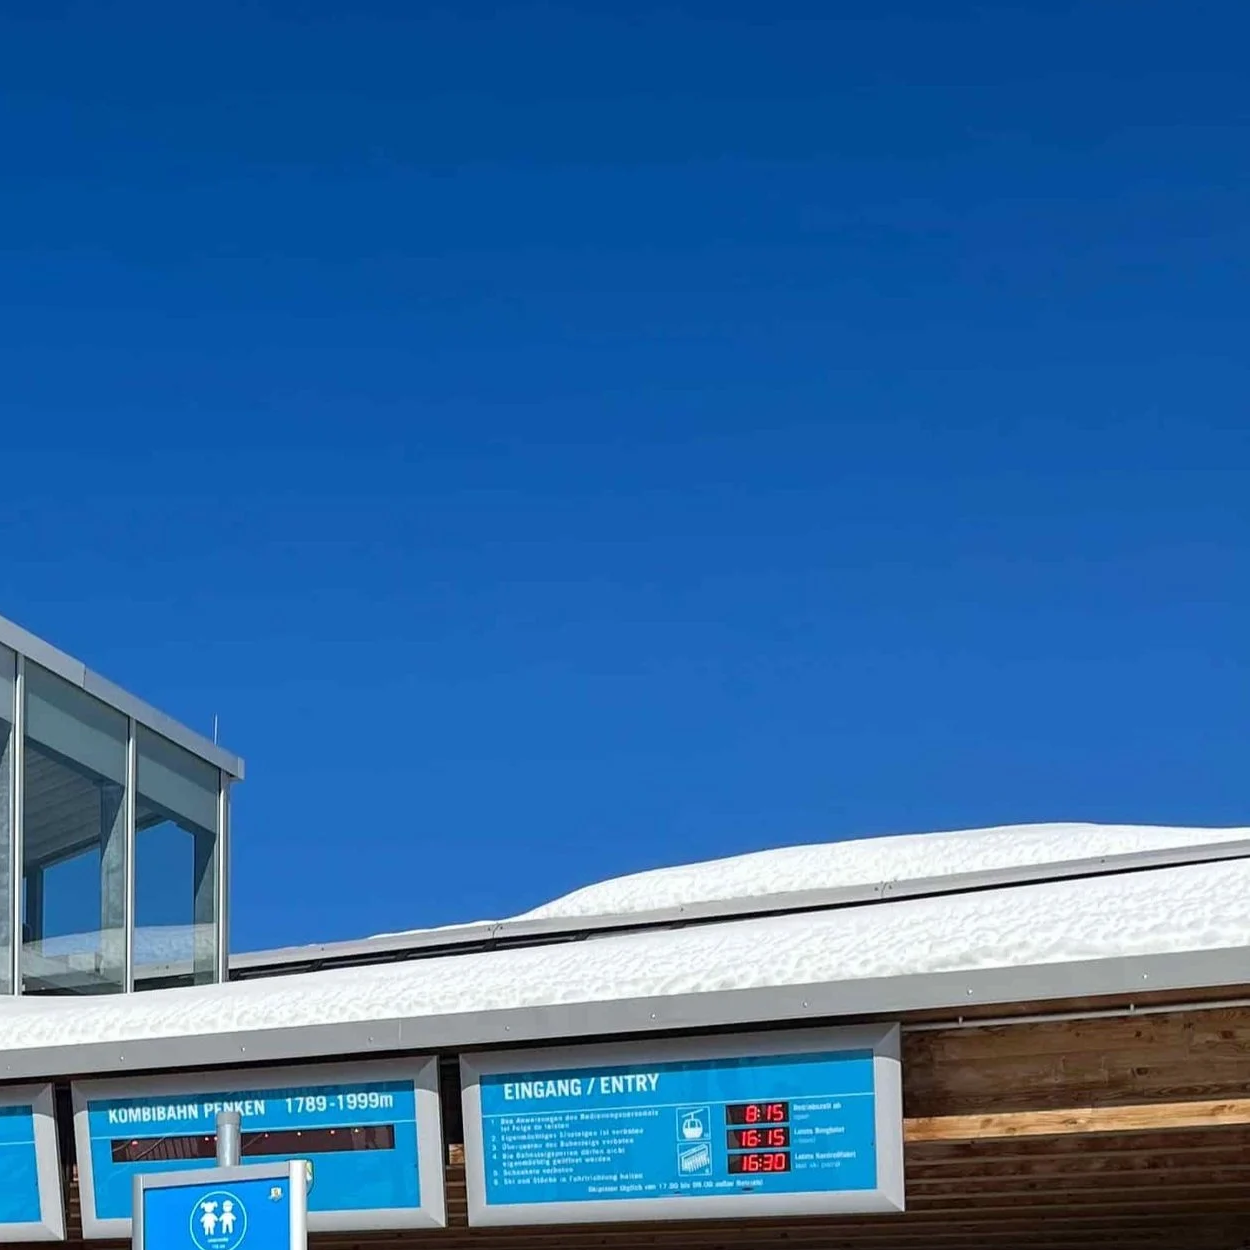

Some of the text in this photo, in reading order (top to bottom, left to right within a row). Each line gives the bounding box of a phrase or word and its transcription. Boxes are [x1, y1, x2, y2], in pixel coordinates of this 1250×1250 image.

[504, 1073, 660, 1100] EINGANG / ENTRY
[108, 1106, 199, 1124] KOMBIBAHN
[204, 1100, 265, 1118] PENKEN
[745, 1104, 784, 1122] 8:15
[741, 1128, 785, 1147] 16:15
[742, 1153, 786, 1172] 16:30
